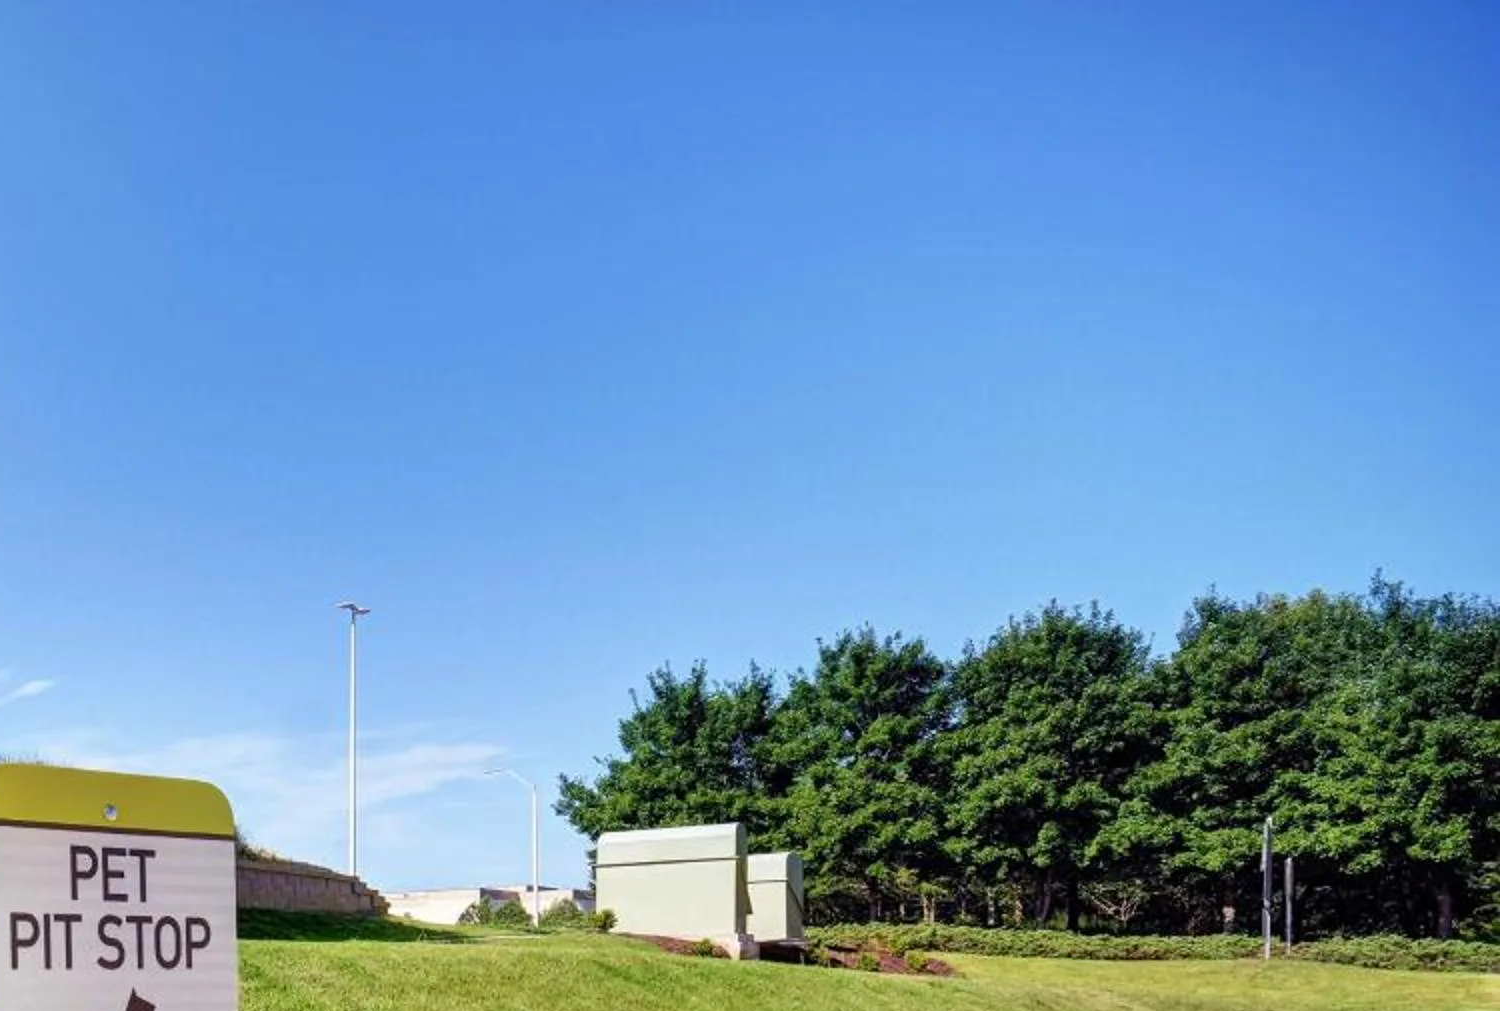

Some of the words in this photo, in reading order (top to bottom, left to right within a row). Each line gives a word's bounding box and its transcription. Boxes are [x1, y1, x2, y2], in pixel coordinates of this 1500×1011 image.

[70, 845, 156, 902] PET
[10, 912, 82, 969] PIT
[97, 914, 211, 970] STOP
